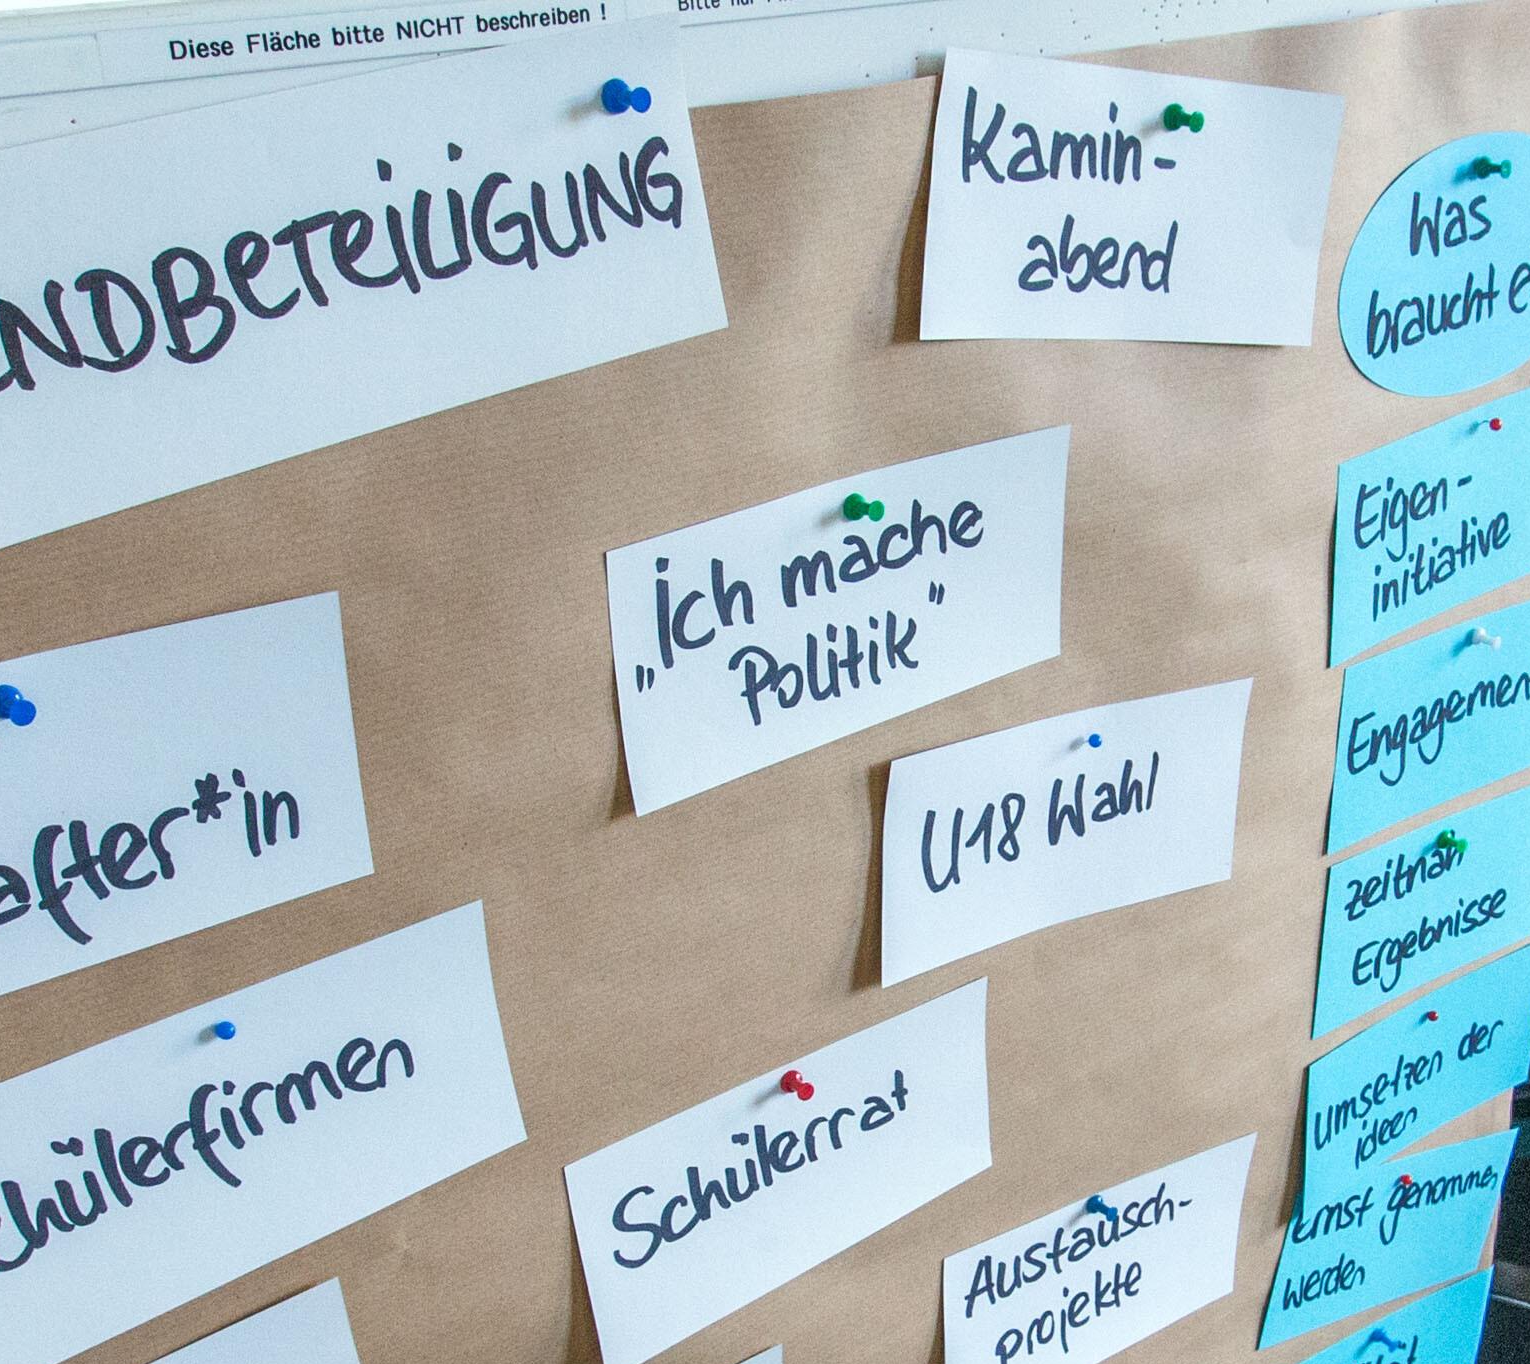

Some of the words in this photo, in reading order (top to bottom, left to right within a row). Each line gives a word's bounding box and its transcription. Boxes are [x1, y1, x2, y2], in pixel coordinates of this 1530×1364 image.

[168, 38, 235, 61] Diese
[245, 30, 321, 54] Fläche
[331, 24, 385, 47] bitte
[395, 15, 465, 41] NICHT
[475, 7, 591, 34] beschreiben
[962, 87, 1175, 184] Kamin-
[1018, 221, 1178, 293] abend
[1409, 192, 1492, 257] Was
[1366, 264, 1499, 359] braucht
[781, 500, 983, 608] mache
[1373, 512, 1510, 620] initiative
[921, 792, 1024, 893] U18
[1047, 751, 1160, 846] Wahl
[1352, 888, 1507, 993] Ergebnisse
[1314, 1050, 1443, 1150] Umsetzen
[1457, 1020, 1504, 1061] der
[612, 1070, 908, 1269] Schülerrat
[1379, 1165, 1498, 1246] genommen
